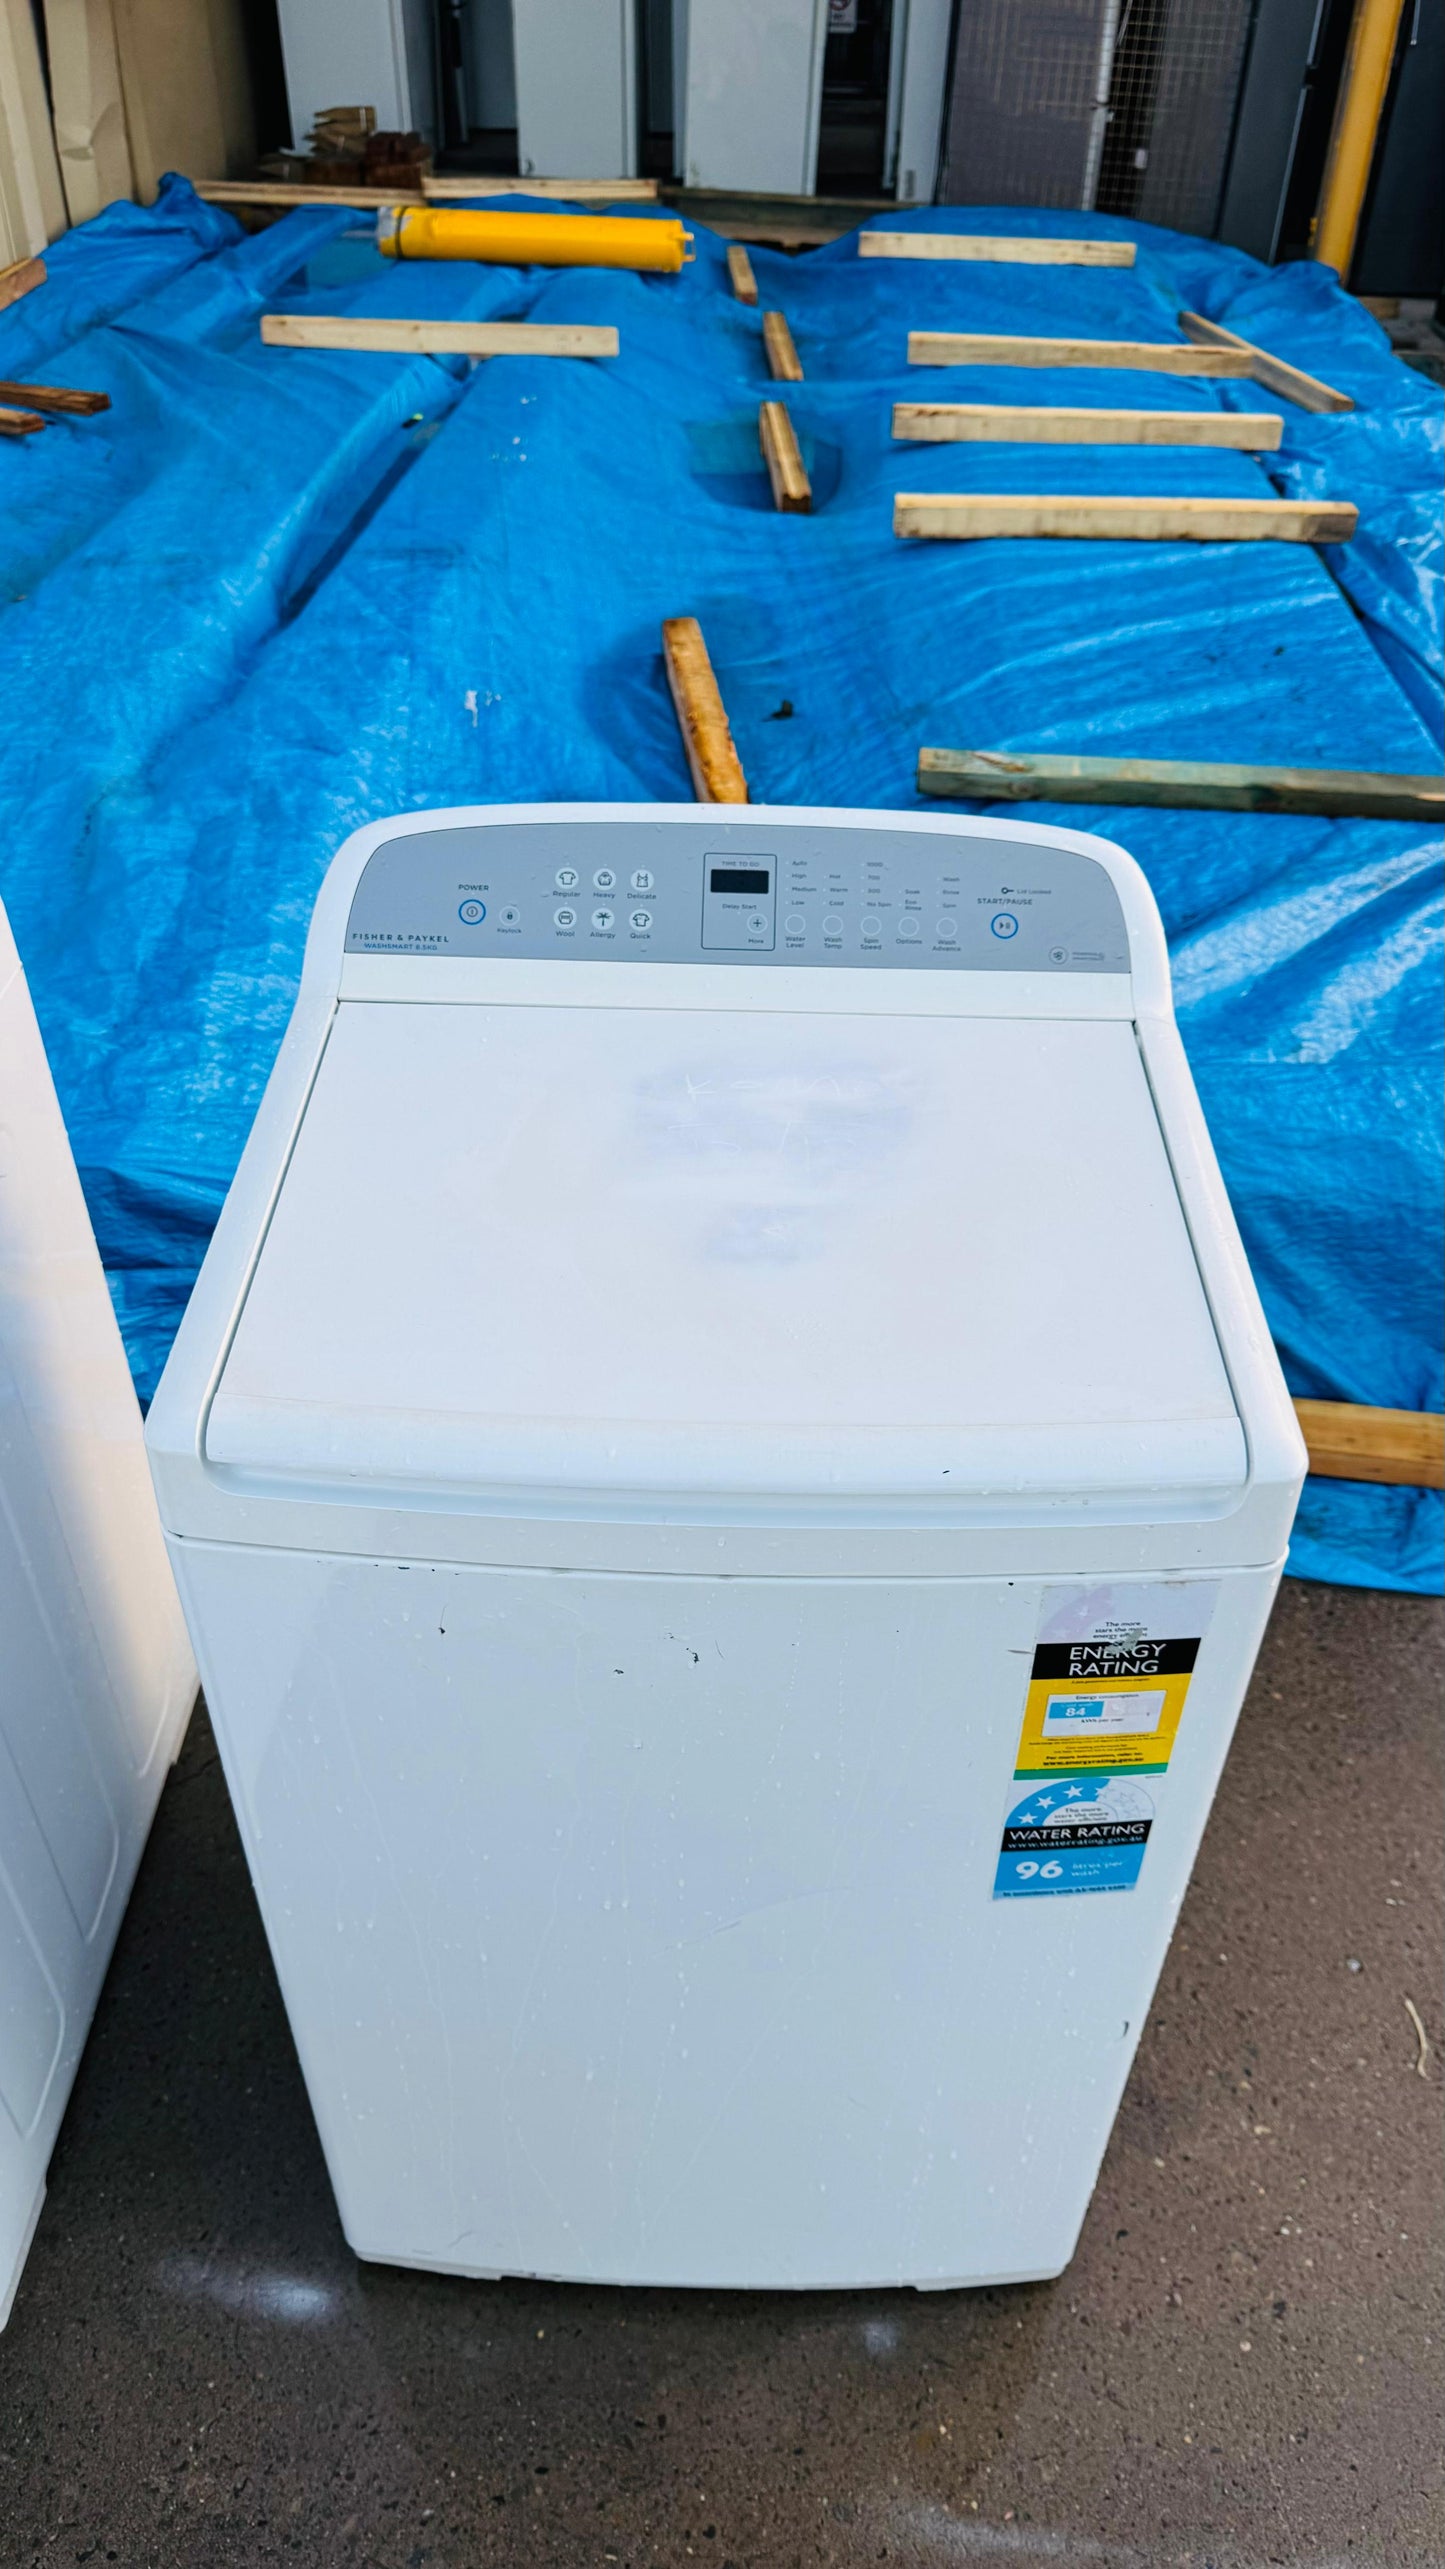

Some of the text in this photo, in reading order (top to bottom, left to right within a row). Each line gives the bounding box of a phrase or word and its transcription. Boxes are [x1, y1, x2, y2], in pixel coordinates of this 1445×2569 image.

[552, 890, 581, 898] Regular
[593, 891, 616, 899] Heavy
[352, 933, 393, 941] FISHER
[408, 935, 449, 943] PAYKEL
[589, 931, 616, 939] Allergy
[1069, 1643, 1167, 1660] ENERGY
[1068, 1659, 1160, 1676] RATING
[1065, 1707, 1086, 1717] 84
[1009, 1823, 1146, 1841] WATER RATING
[1015, 1860, 1064, 1880] 96
